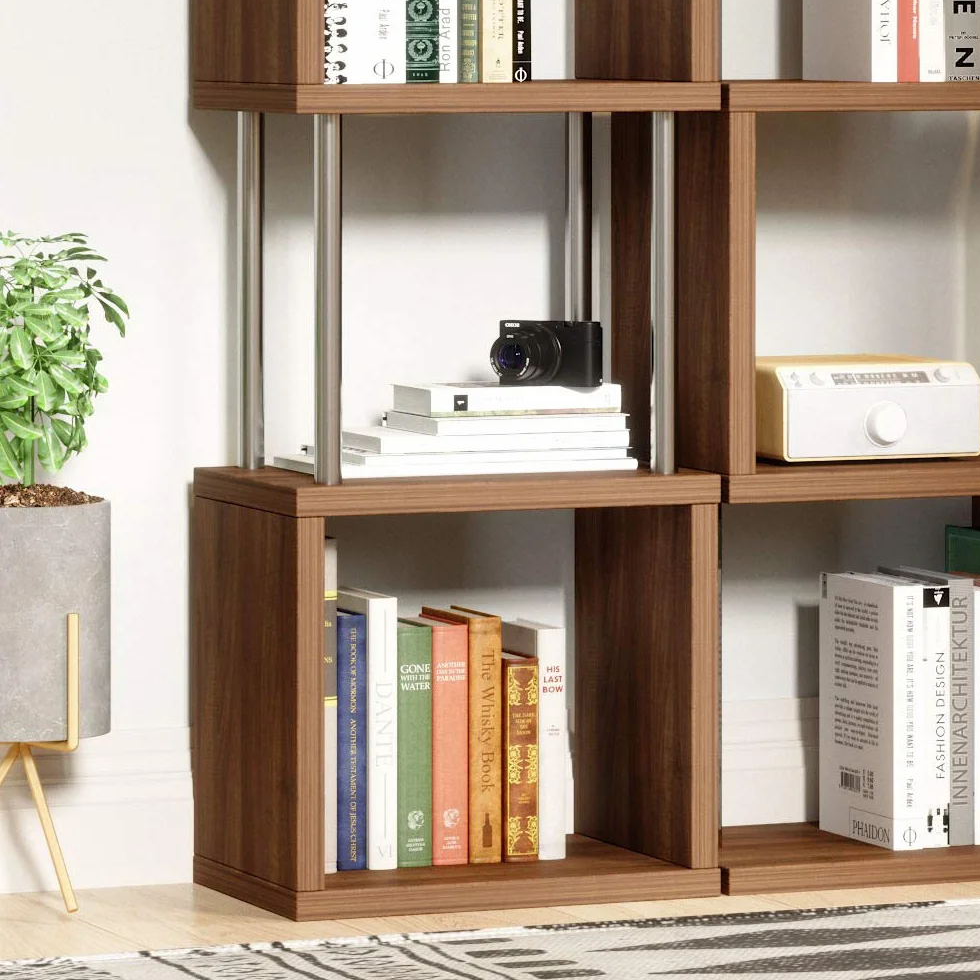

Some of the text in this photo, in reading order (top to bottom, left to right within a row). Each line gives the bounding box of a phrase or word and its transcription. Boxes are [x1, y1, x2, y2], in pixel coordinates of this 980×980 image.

[439, 7, 451, 72] Ron Arad
[955, 47, 975, 68] Z
[349, 627, 357, 713] THE BOOK OF MORMON
[400, 663, 431, 674] GONE
[401, 682, 431, 691] WATER
[543, 675, 563, 683] LAST
[935, 652, 946, 780] FASHION DESIGN
[951, 596, 968, 806] INNENARCHITEKTUR
[349, 719, 357, 756] ANOTHER
[375, 680, 393, 768] DANTE
[477, 650, 495, 793] The Whisky Book
[905, 734, 914, 749] WANT
[349, 757, 357, 801] TESTAMENT
[349, 835, 357, 863] CHRIST
[852, 819, 890, 844] PHAIDON
